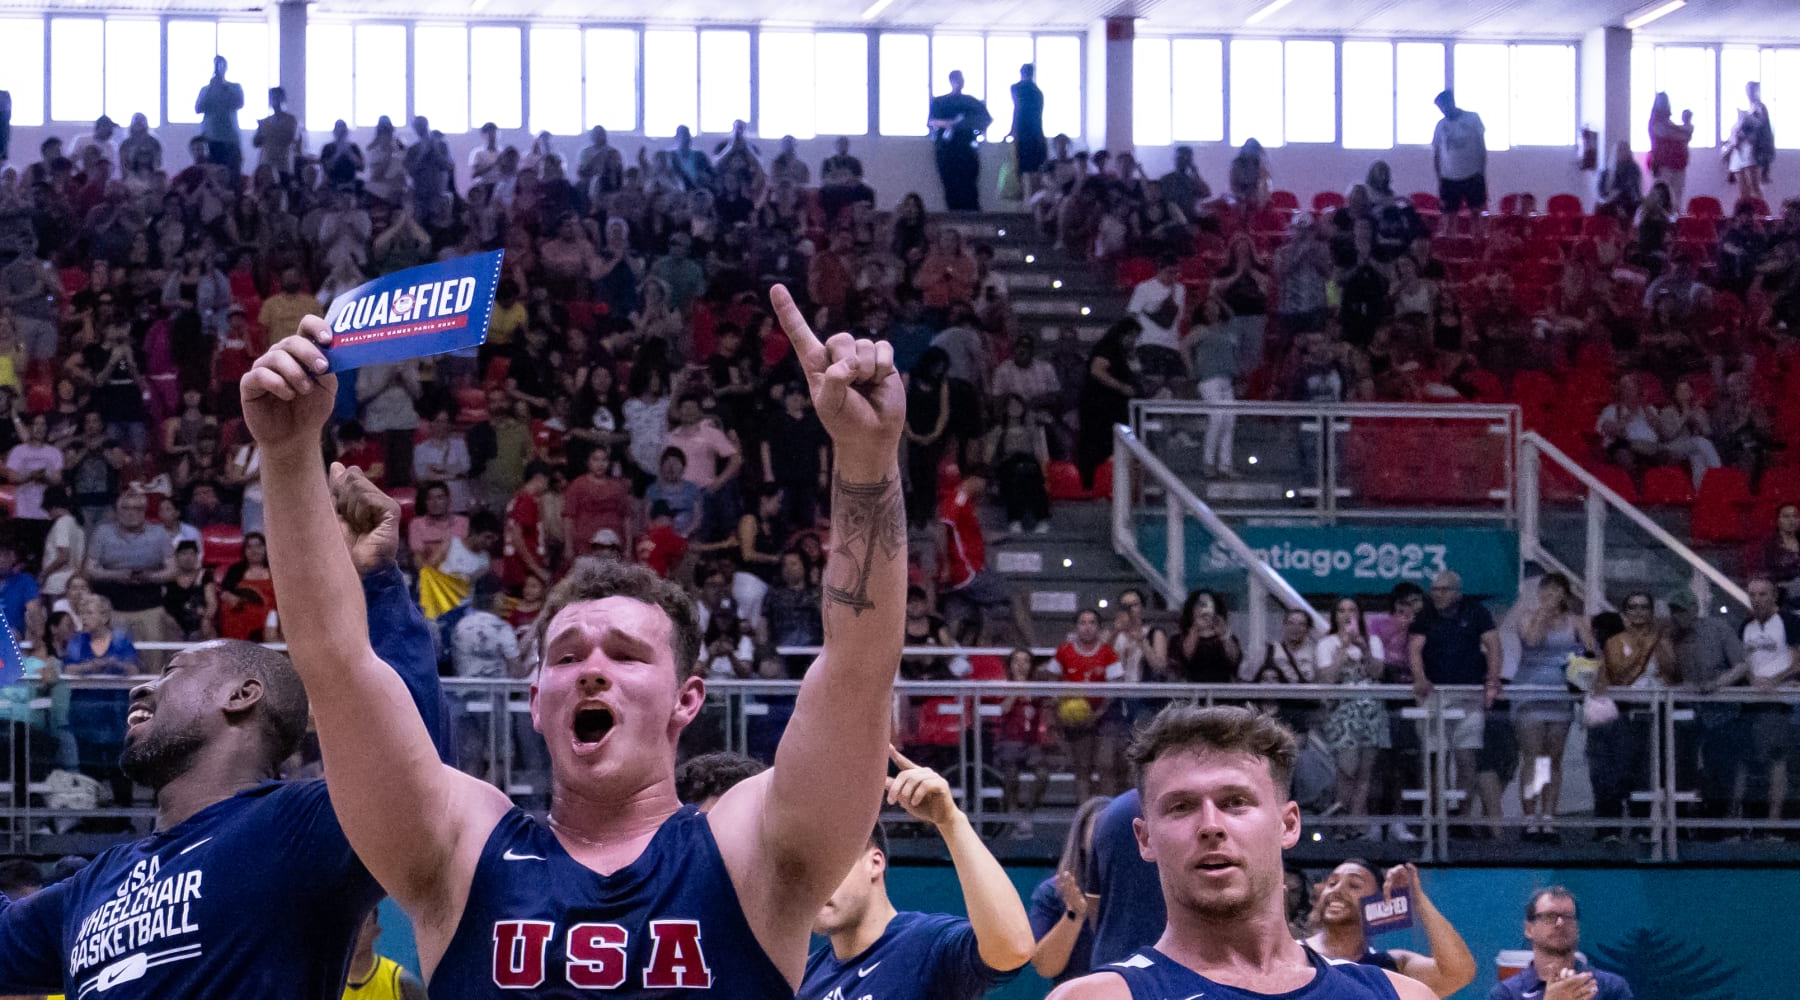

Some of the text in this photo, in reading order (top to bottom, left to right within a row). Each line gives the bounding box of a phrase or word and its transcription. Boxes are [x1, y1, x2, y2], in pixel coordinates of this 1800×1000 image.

[333, 276, 476, 333] QUALIFIED
[1353, 542, 1448, 580] 2023
[69, 902, 200, 978] BASKETBALL
[75, 869, 203, 944] WHEELCHAIR
[492, 919, 712, 990] USA
